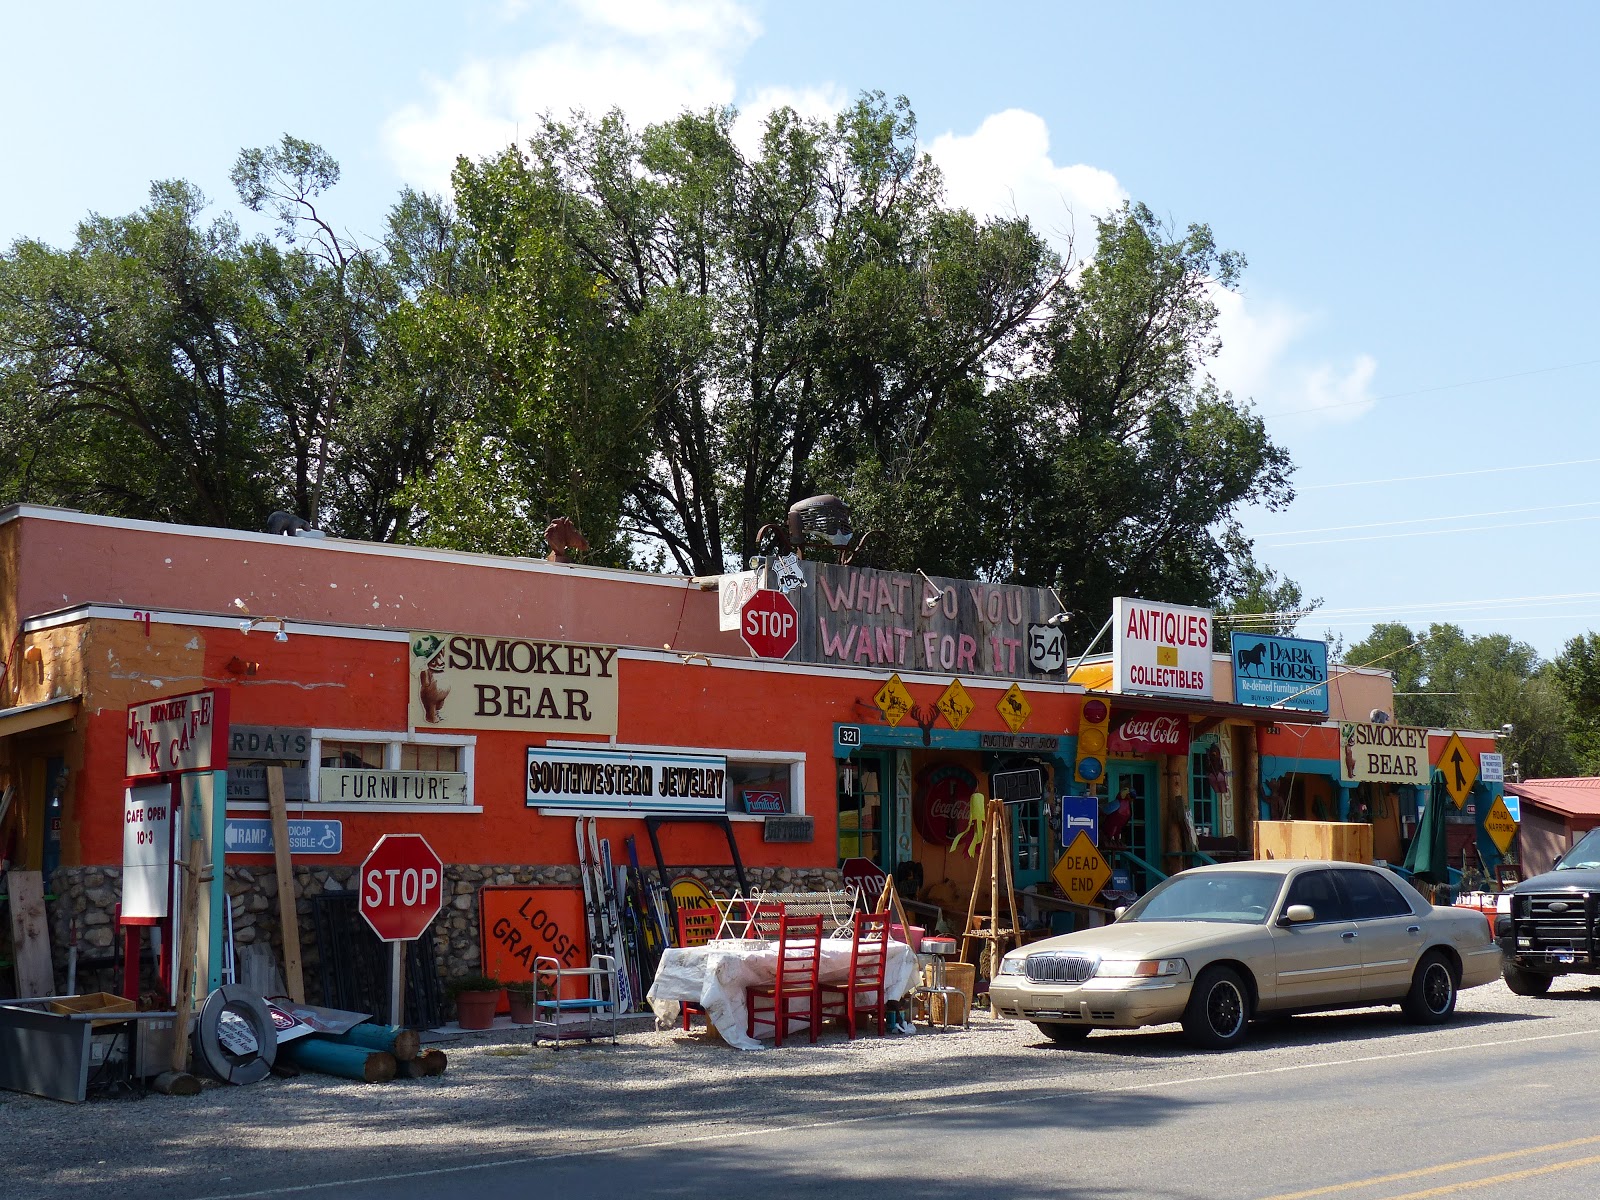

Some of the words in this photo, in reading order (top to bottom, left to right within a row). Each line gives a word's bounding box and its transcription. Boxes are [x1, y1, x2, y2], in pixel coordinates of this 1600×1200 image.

[819, 573, 911, 615] WHAT
[922, 579, 958, 620] DO
[970, 586, 1022, 625] YOU
[746, 609, 794, 638] STOP
[1126, 608, 1208, 648] ANTIQUES
[819, 617, 912, 665] WANT
[923, 631, 977, 673] FOR
[990, 637, 1022, 673] IT
[1033, 635, 1061, 662] 54
[1269, 642, 1314, 664] DARK
[449, 636, 617, 678] SMOKEY
[1130, 665, 1204, 690] COLLECTIBLES
[1270, 662, 1323, 682] HORSE
[1242, 680, 1273, 692] Re-defined
[1273, 682, 1299, 694] Furniture
[474, 684, 592, 721] BEAR
[128, 711, 161, 772] JUNK
[169, 696, 211, 767] CAFE
[842, 730, 857, 743] 321
[982, 734, 1015, 748] AUCTION
[1120, 717, 1180, 744] Coca-Cola
[1356, 723, 1428, 748] SMOKEY
[232, 732, 306, 753] RDAYS
[235, 768, 268, 779] VINTA
[1367, 753, 1418, 776] BEAR
[227, 785, 250, 796] EMS
[341, 775, 450, 800] FURNITURE
[529, 761, 653, 796] SOUTHWESTERN
[658, 767, 725, 799] JEWELRY
[996, 772, 1040, 800] OPEN
[126, 808, 144, 824] CAFE
[147, 806, 166, 821] OPEN
[1492, 811, 1508, 820] ROAD
[238, 828, 267, 844] RAMP
[288, 826, 312, 836] DICAP
[1488, 823, 1514, 832] NARROWS
[1067, 856, 1098, 870] DEAD
[365, 868, 438, 908] STOP
[844, 875, 886, 896] STOP
[1071, 878, 1094, 892] END
[518, 897, 580, 968] LOOSE
